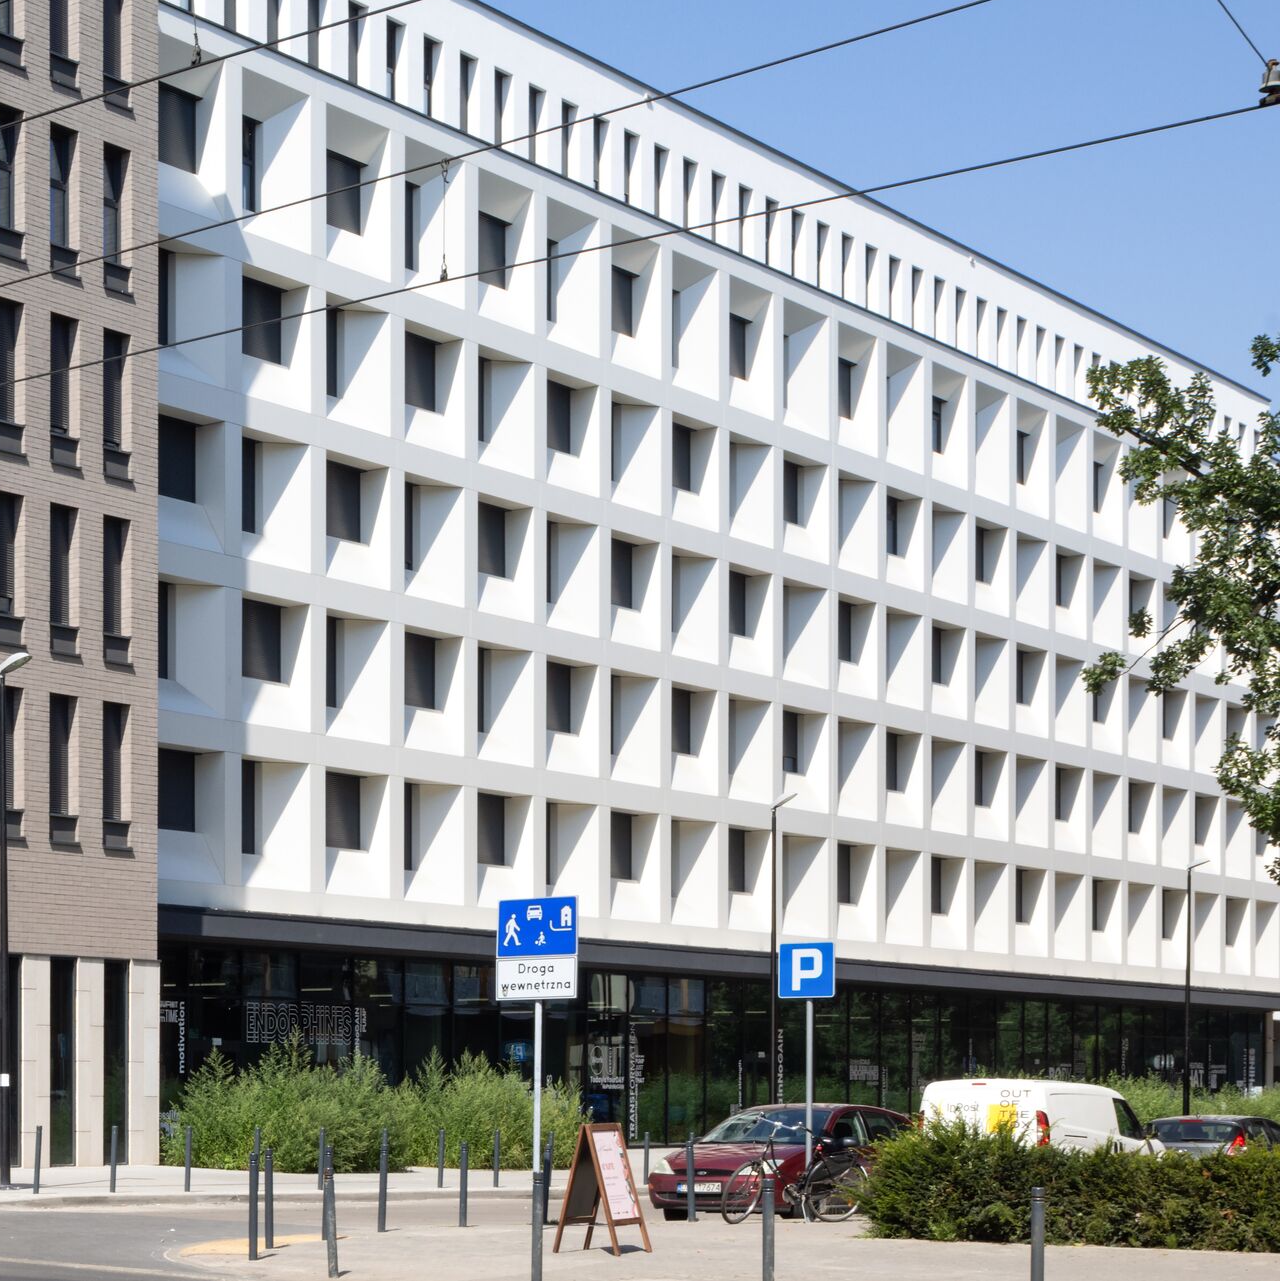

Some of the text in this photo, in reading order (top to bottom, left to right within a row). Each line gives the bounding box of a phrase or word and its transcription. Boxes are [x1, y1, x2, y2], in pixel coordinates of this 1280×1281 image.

[518, 963, 554, 976] Droga
[791, 948, 823, 991] P
[501, 980, 571, 992] wewnętrzna
[177, 1000, 186, 1074] motivation
[1000, 1089, 1032, 1098] OUT
[947, 1102, 980, 1113] InPost
[999, 1099, 1021, 1108] OF
[999, 1110, 1030, 1119] THE
